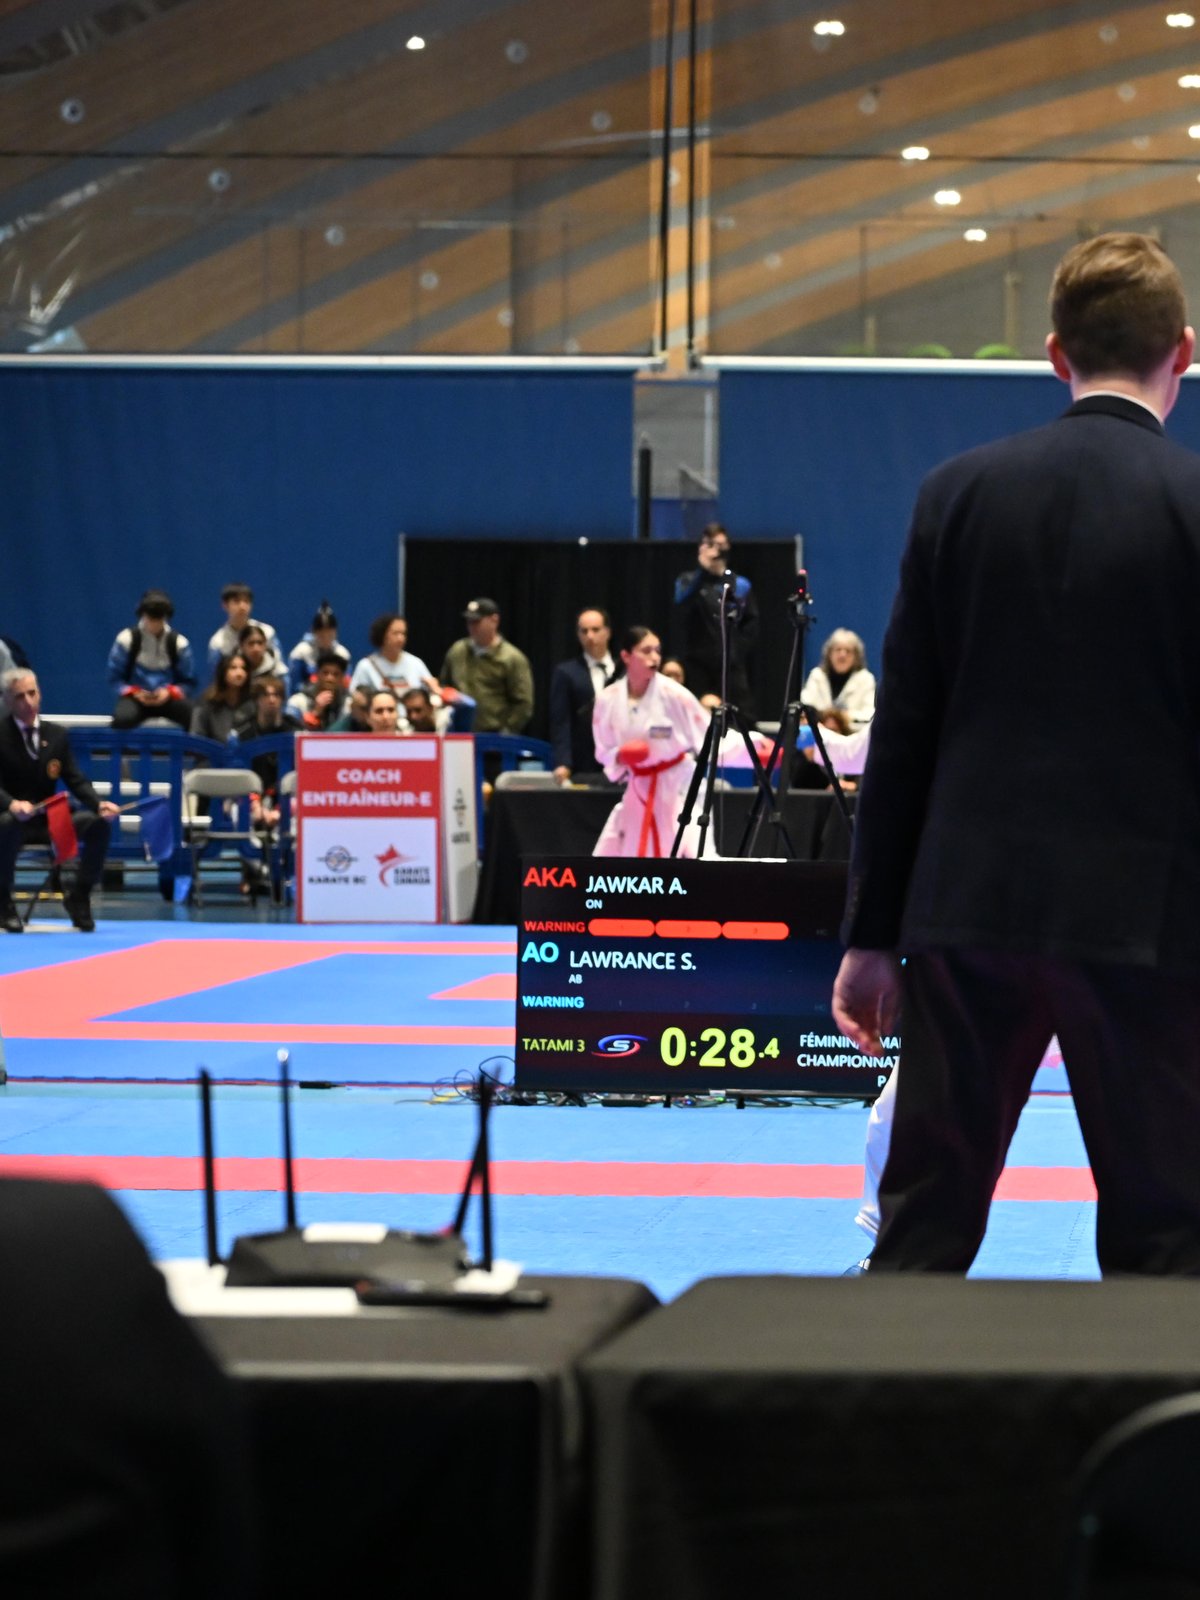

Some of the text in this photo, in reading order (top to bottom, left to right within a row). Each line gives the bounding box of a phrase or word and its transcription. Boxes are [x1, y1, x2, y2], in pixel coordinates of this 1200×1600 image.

[337, 769, 401, 783] COACH
[524, 867, 576, 888] AKA
[586, 876, 687, 894] JAWKAR A.
[586, 899, 602, 909] ON
[524, 921, 585, 933] WARNING
[522, 942, 559, 963] AO
[570, 951, 697, 970] LAWRANCE S.
[568, 974, 583, 984] AB
[522, 996, 584, 1008] WARNING
[522, 1038, 585, 1052] TATAMI 3
[800, 1032, 859, 1050] FÉMININ
